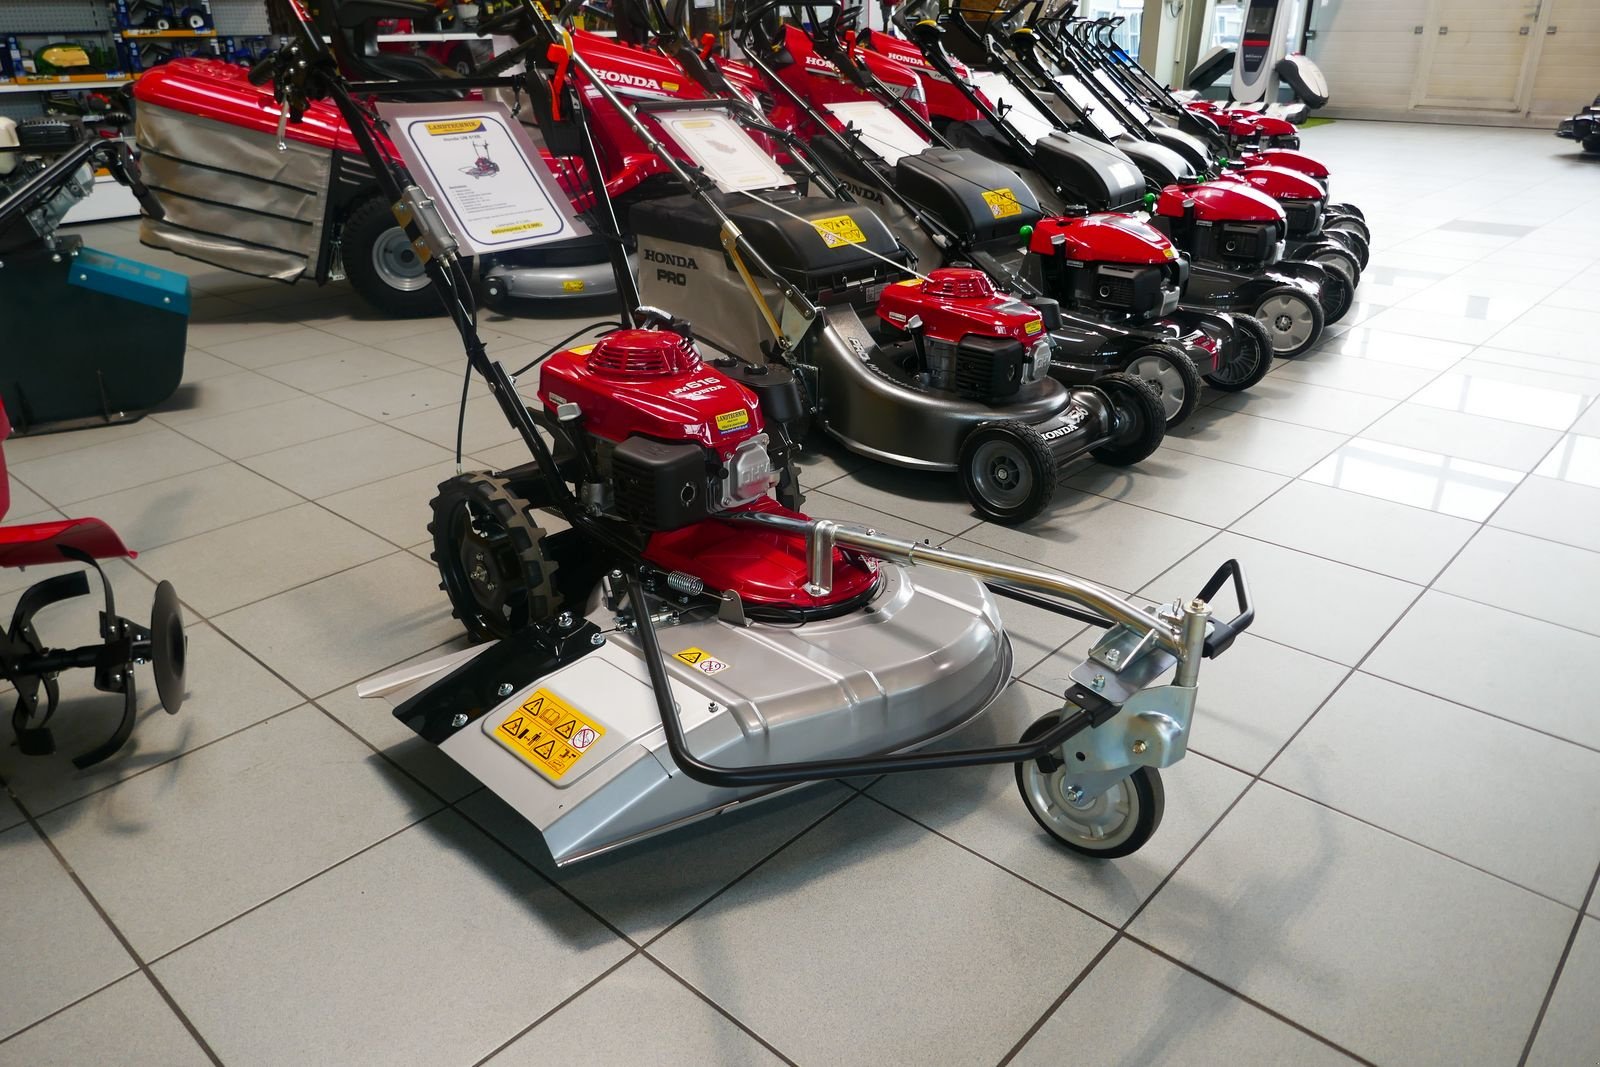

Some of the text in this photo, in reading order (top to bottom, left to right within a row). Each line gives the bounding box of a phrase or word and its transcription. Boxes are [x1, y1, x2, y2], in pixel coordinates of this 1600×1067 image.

[805, 56, 841, 72] HON
[888, 52, 924, 66] HONDA
[591, 68, 661, 90] HONDA
[428, 121, 477, 130] LANDTECHNIK
[840, 180, 884, 206] ONDA
[644, 249, 699, 270] HONDA
[657, 269, 687, 286] PRO
[669, 377, 721, 395] UM616
[716, 410, 746, 423] LANDTECHNIK
